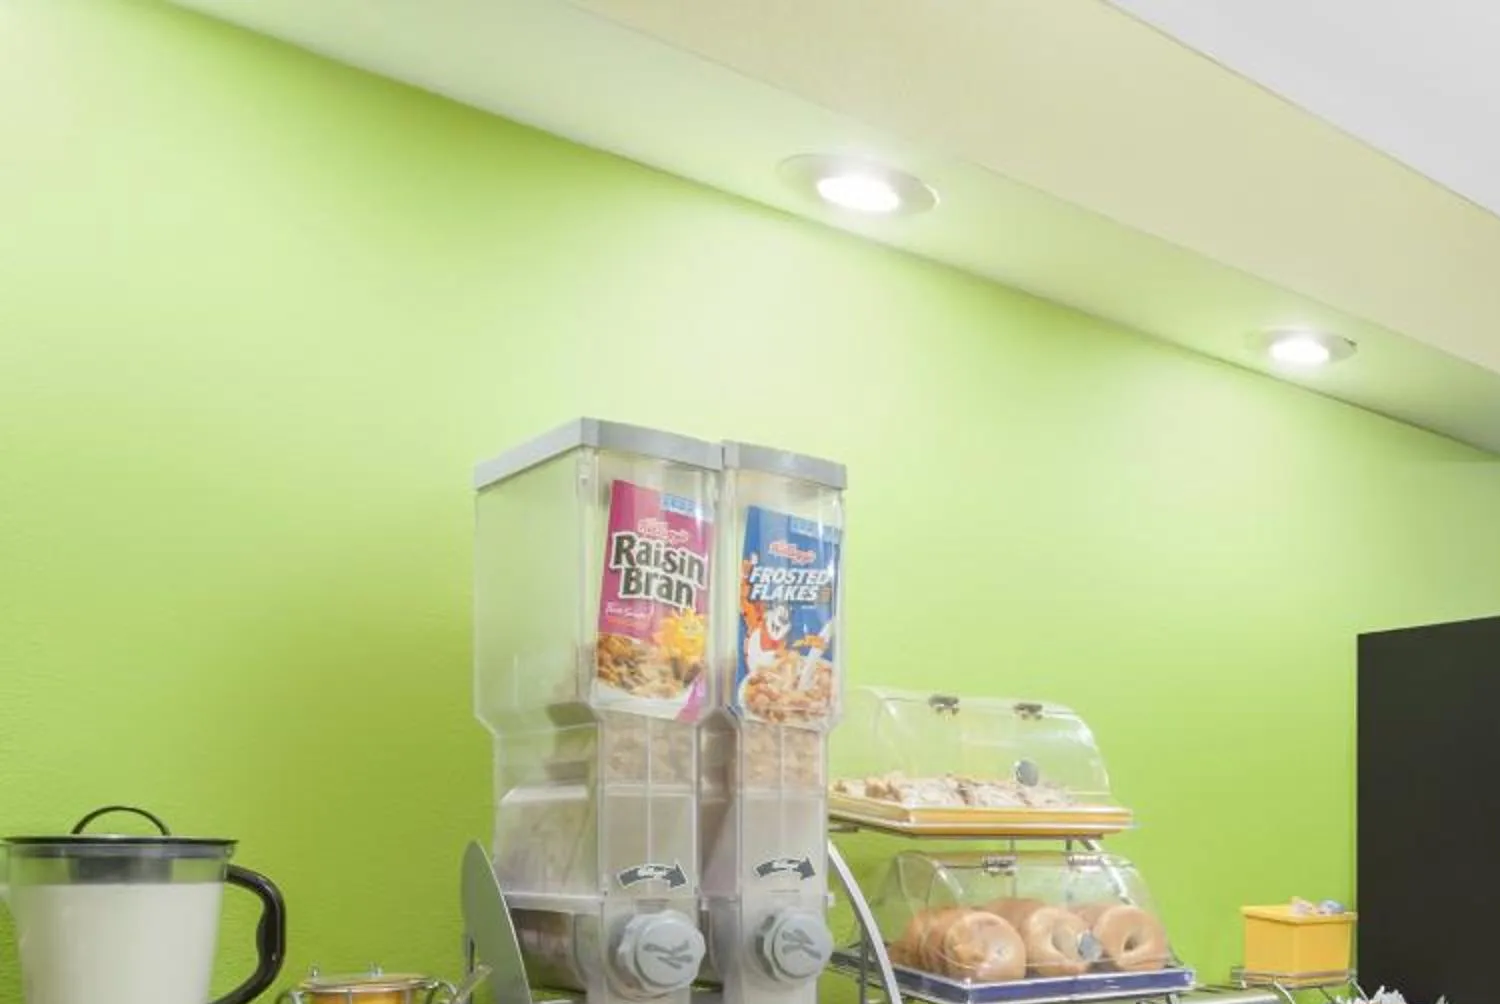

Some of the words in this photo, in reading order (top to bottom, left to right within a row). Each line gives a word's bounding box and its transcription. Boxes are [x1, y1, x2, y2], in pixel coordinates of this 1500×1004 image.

[612, 533, 706, 587] Raisin
[620, 565, 694, 609] Bran
[750, 567, 830, 585] FROSTED
[750, 583, 818, 600] FLAKES
